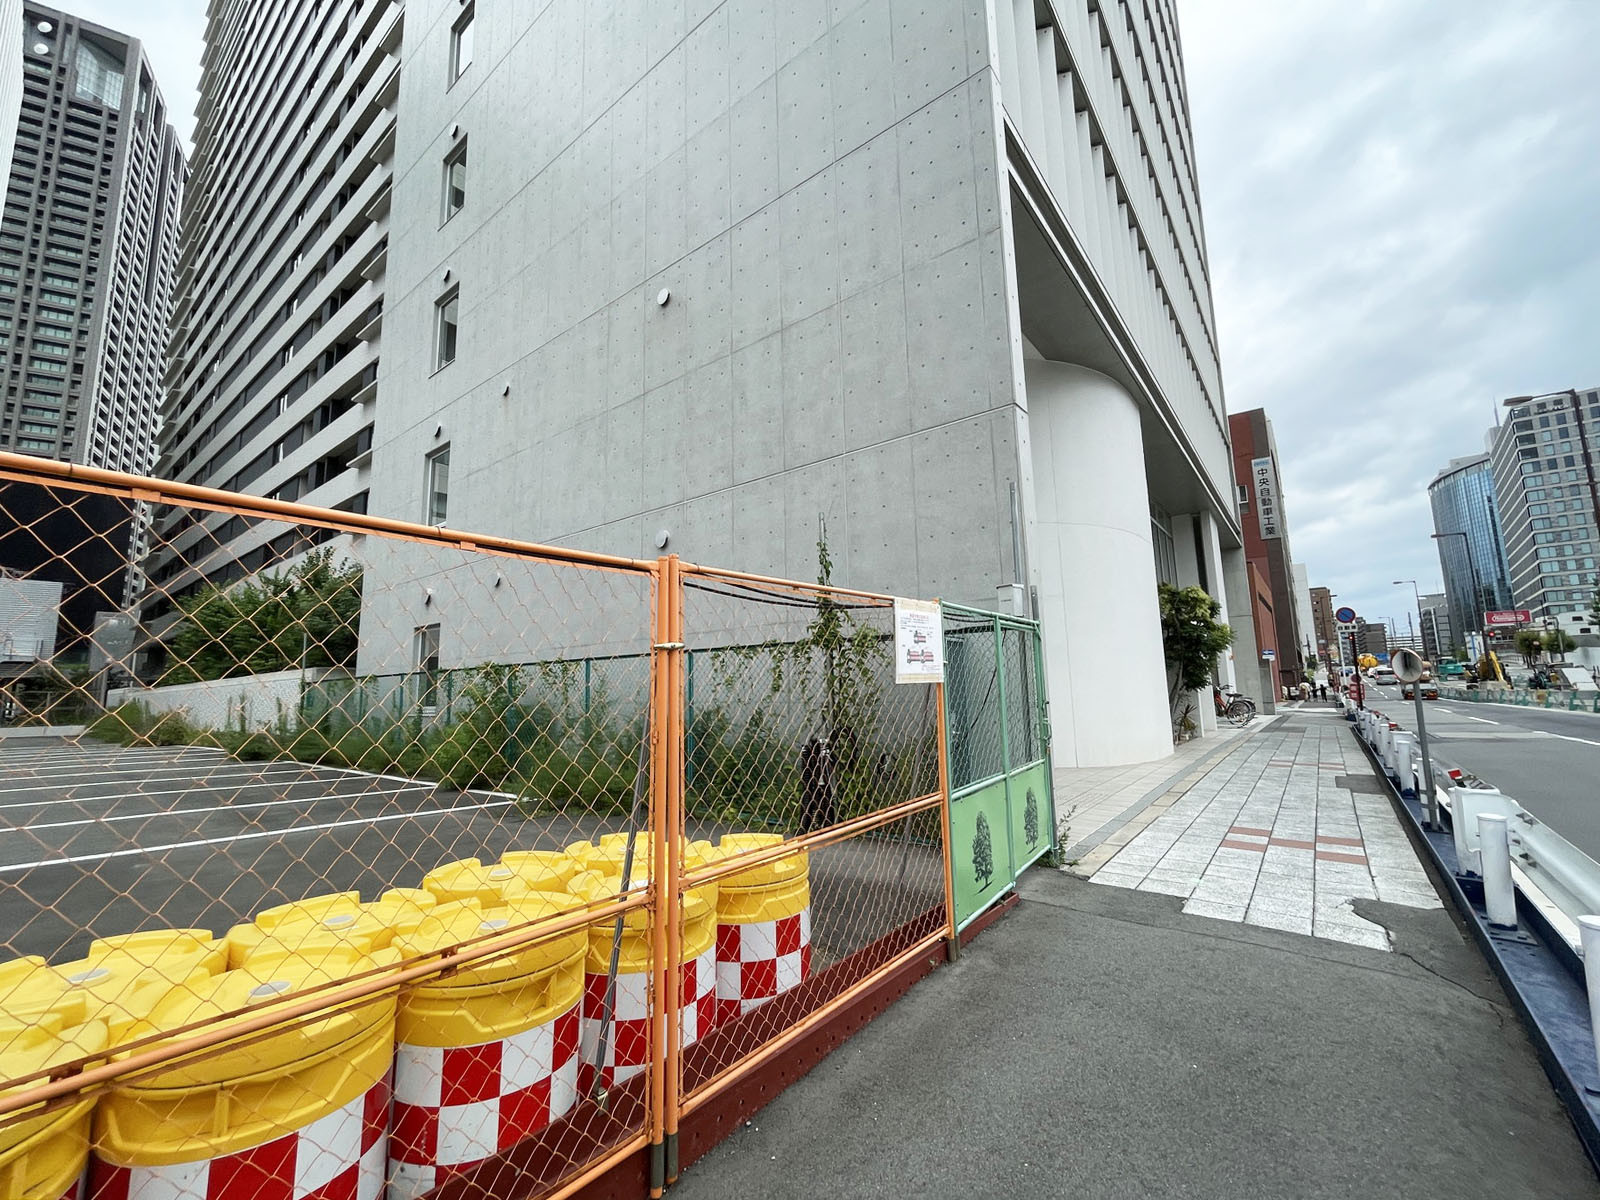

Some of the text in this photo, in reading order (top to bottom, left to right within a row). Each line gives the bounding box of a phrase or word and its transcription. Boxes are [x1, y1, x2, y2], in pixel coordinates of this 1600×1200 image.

[1257, 468, 1276, 535] 中央自動車工業
